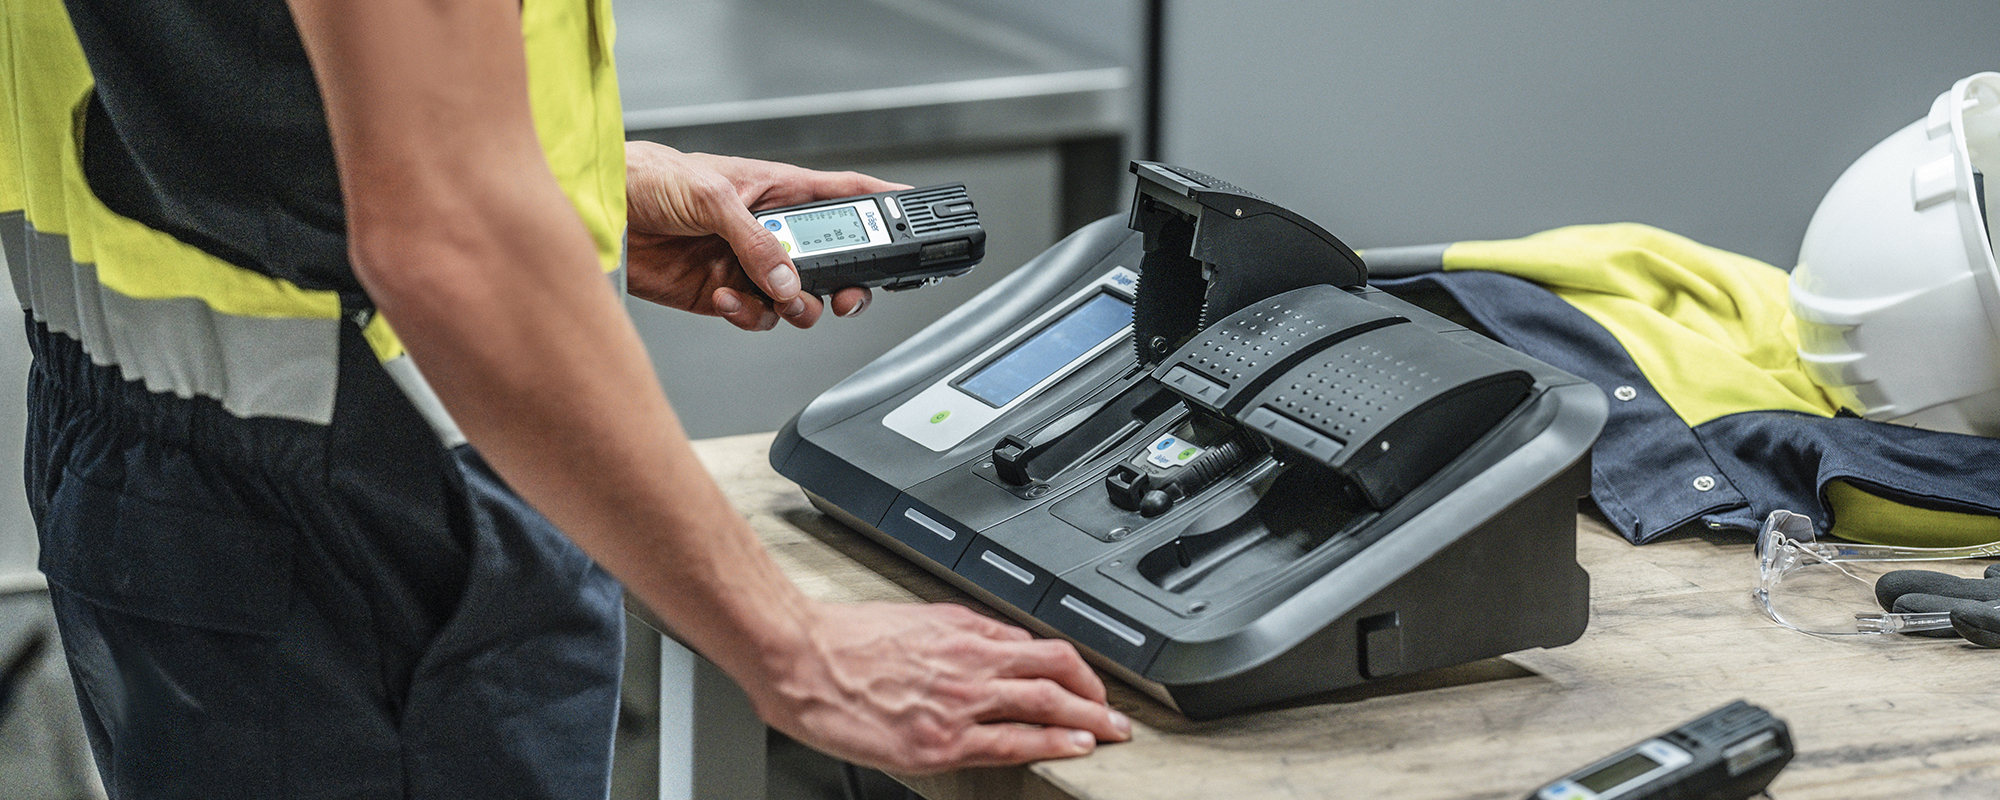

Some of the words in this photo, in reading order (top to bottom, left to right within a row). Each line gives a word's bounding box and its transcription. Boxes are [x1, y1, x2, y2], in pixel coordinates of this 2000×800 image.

[865, 212, 879, 231] Dräger
[823, 233, 833, 243] 0.0
[833, 229, 844, 240] 20.9
